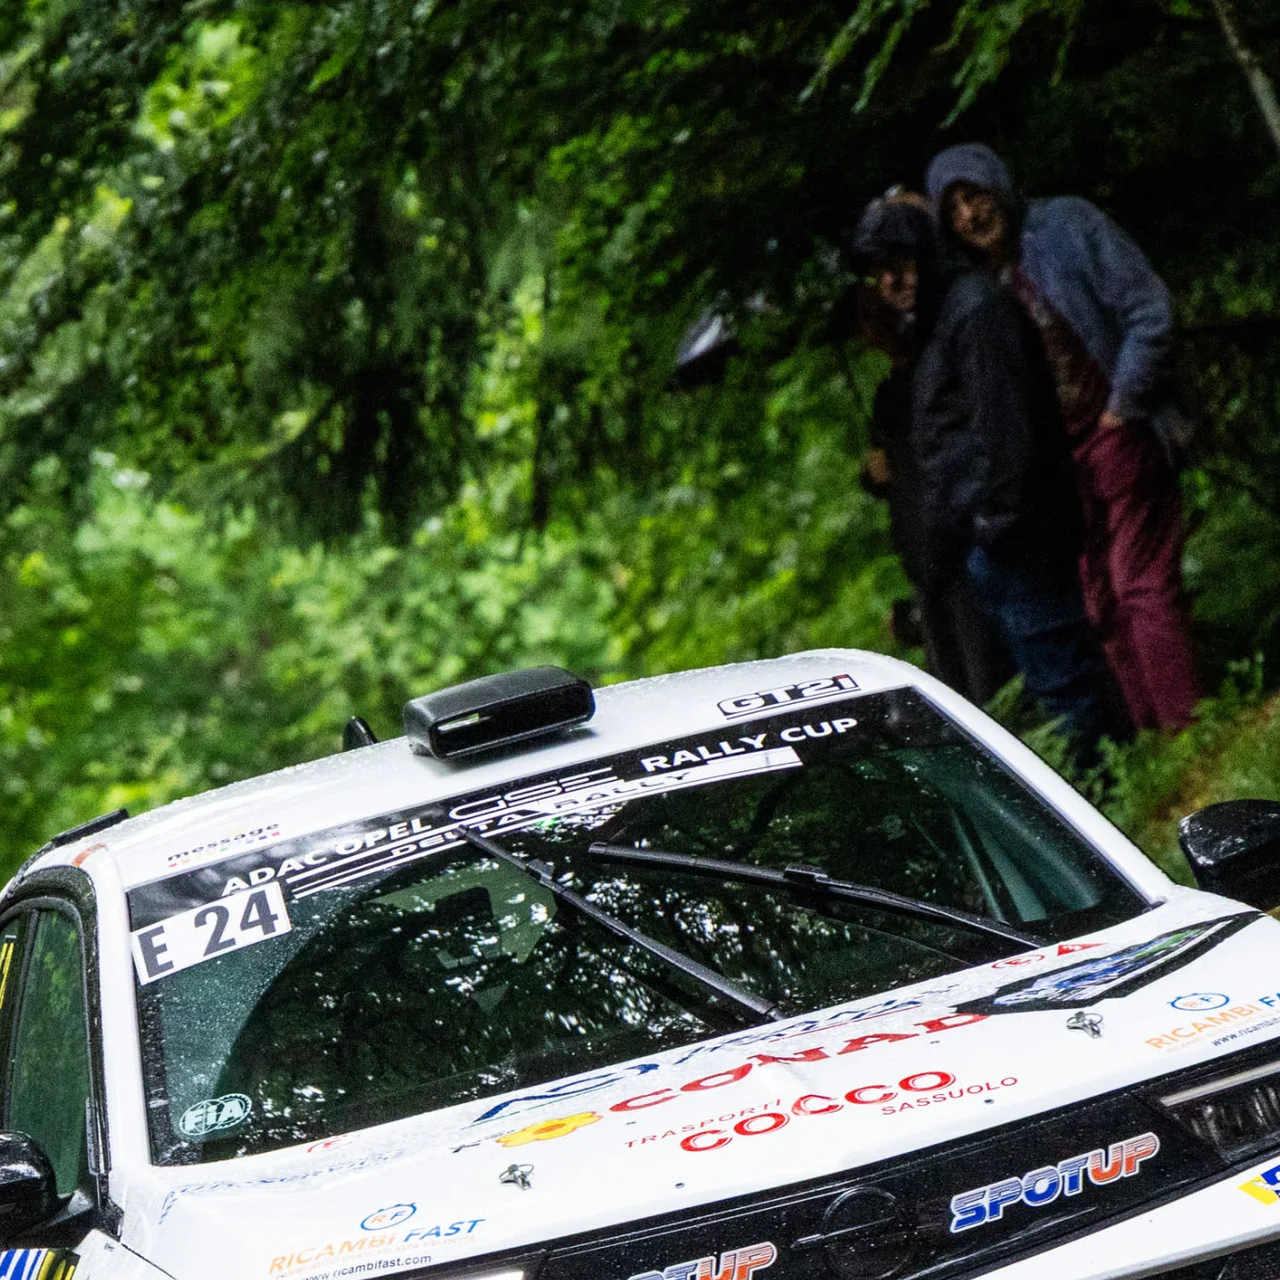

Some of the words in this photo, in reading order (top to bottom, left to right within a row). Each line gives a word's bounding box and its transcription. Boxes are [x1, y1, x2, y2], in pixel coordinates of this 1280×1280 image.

[717, 674, 859, 716] GT2i
[221, 850, 327, 897] ADAC
[335, 818, 433, 854] OPEL
[448, 767, 618, 820] GSE
[640, 733, 767, 772] RALLY
[780, 718, 858, 742] CUP
[167, 822, 280, 862] message
[138, 925, 175, 980] E
[194, 890, 279, 957] 24
[1144, 1004, 1262, 1049] RICAMBI
[609, 1013, 992, 1112] CONAD
[625, 1098, 781, 1148] TRASPORTI
[680, 1071, 956, 1152] COCCO
[881, 1077, 1018, 1115] SASSUOLO
[949, 1132, 1161, 1233] SPOTUP
[268, 1233, 397, 1274] RICAMBI
[404, 1219, 486, 1243] FAST
